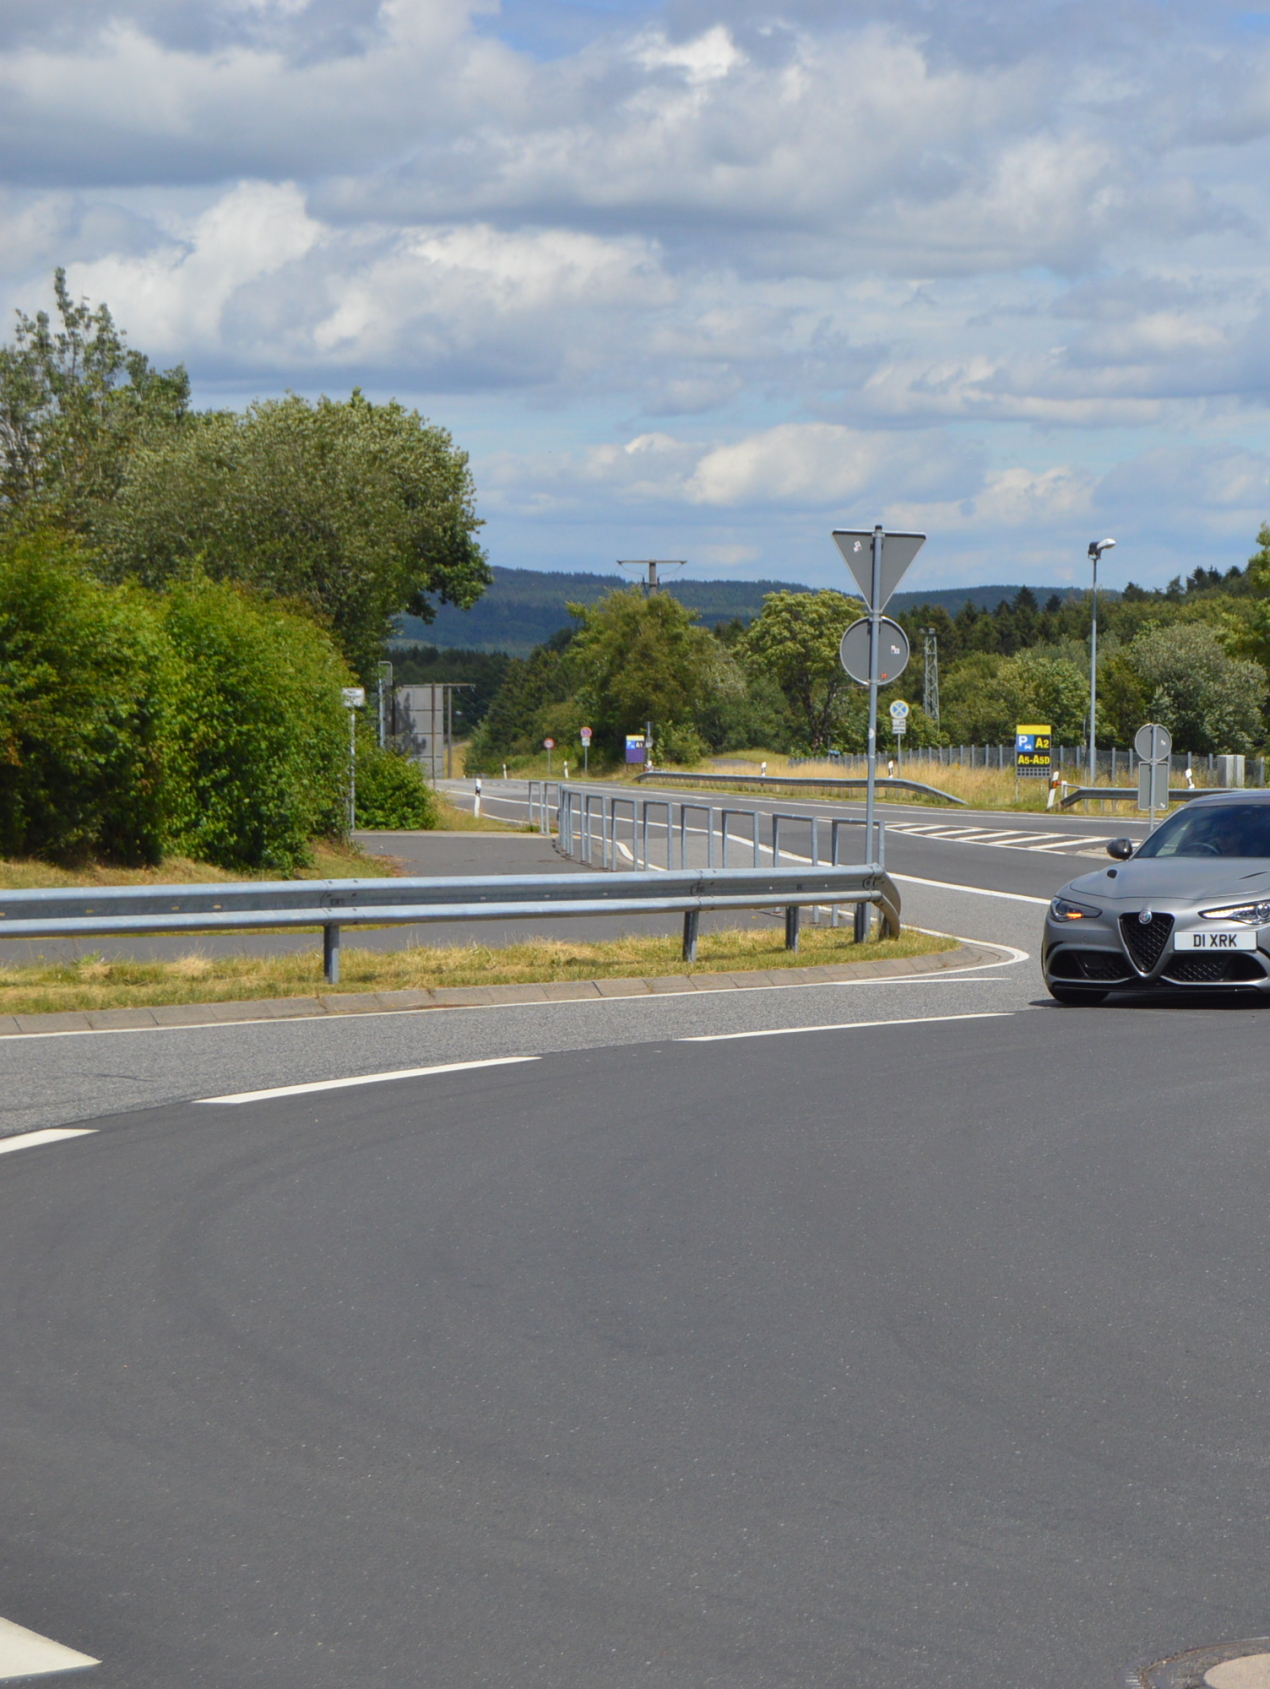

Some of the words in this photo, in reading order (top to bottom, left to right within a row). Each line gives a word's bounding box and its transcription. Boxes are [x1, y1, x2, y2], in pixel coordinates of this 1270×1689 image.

[1019, 735, 1028, 747] P
[1035, 737, 1050, 749] A2
[1017, 754, 1051, 765] A5-A5D
[1210, 934, 1237, 947] XRK
